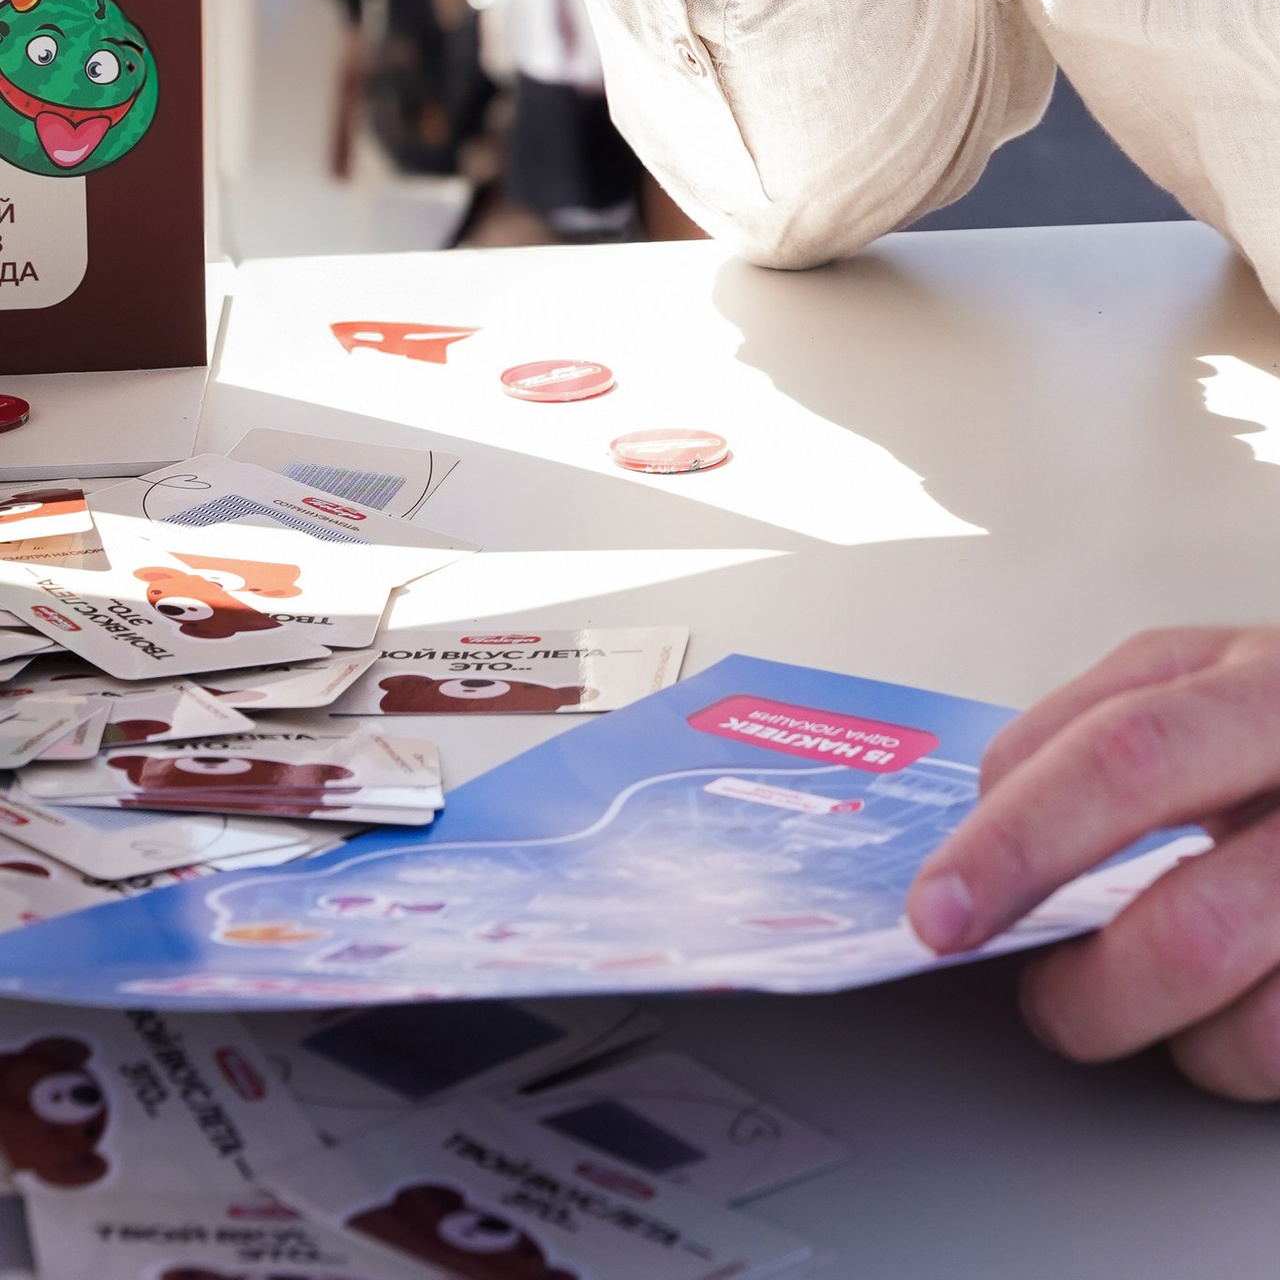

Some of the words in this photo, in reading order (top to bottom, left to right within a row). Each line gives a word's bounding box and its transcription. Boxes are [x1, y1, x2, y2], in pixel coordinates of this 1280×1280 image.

[37, 578, 89, 606] ЛЕТА
[73, 605, 131, 634] ВКУС
[264, 612, 334, 626] ТВО
[111, 631, 175, 661] ТВОЙ
[441, 650, 532, 660] ВКУС
[530, 648, 608, 660] ЛЕТА
[748, 709, 845, 736] ЛОКАЦИЯ
[718, 716, 864, 758] НАКЛЕЕК
[845, 728, 901, 749] ОДНА
